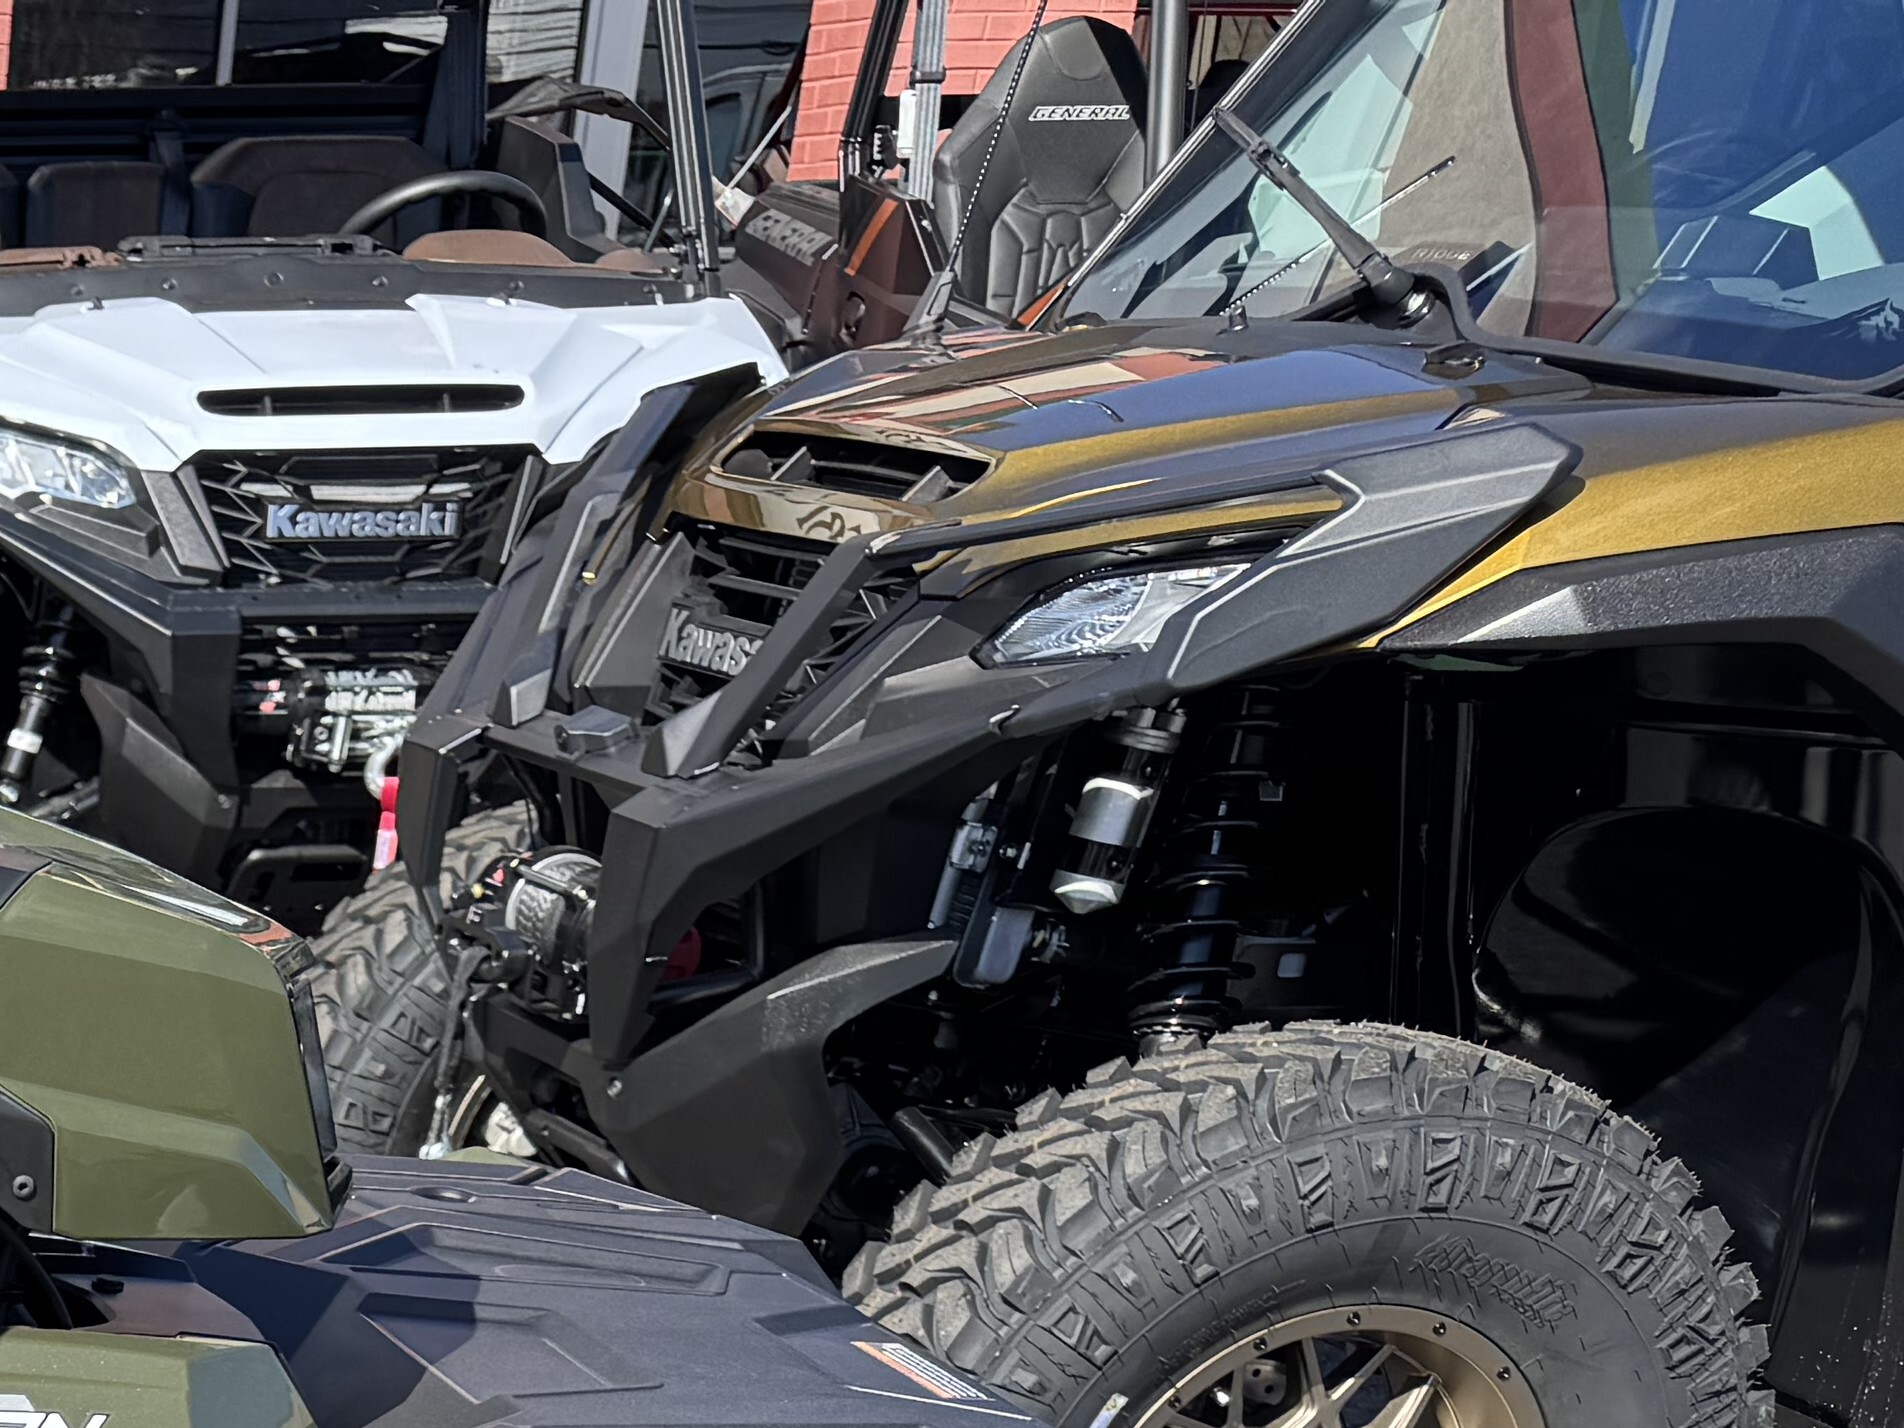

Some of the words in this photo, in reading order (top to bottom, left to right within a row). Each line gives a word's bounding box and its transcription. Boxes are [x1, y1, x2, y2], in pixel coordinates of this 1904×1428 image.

[1029, 105, 1130, 121] GENERAL
[267, 502, 460, 539] Kawasaki
[659, 607, 763, 676] Kawas
